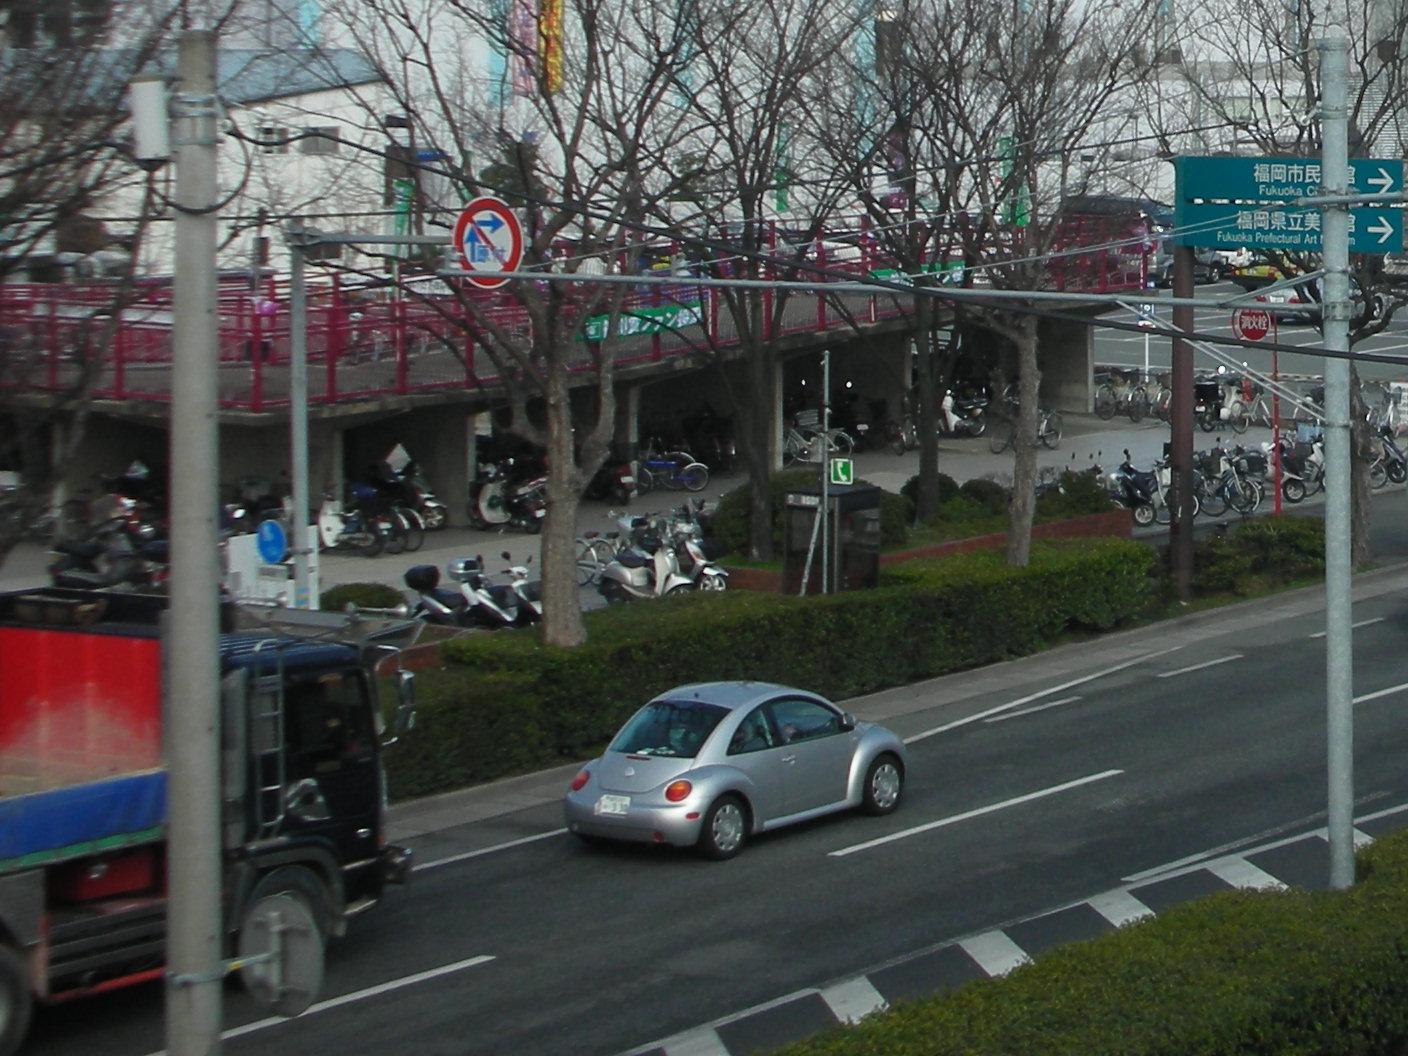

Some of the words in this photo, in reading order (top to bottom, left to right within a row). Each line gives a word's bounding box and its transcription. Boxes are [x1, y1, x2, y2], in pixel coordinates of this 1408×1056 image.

[1253, 163, 1356, 184] 福岡市民
[1258, 184, 1303, 196] Fukuoka
[1237, 210, 1356, 233] 福岡県立美
[1216, 231, 1253, 243] Fukuoka
[1255, 232, 1301, 245] Prefectural
[1303, 232, 1318, 245] Art
[1240, 315, 1268, 330] 消火栓
